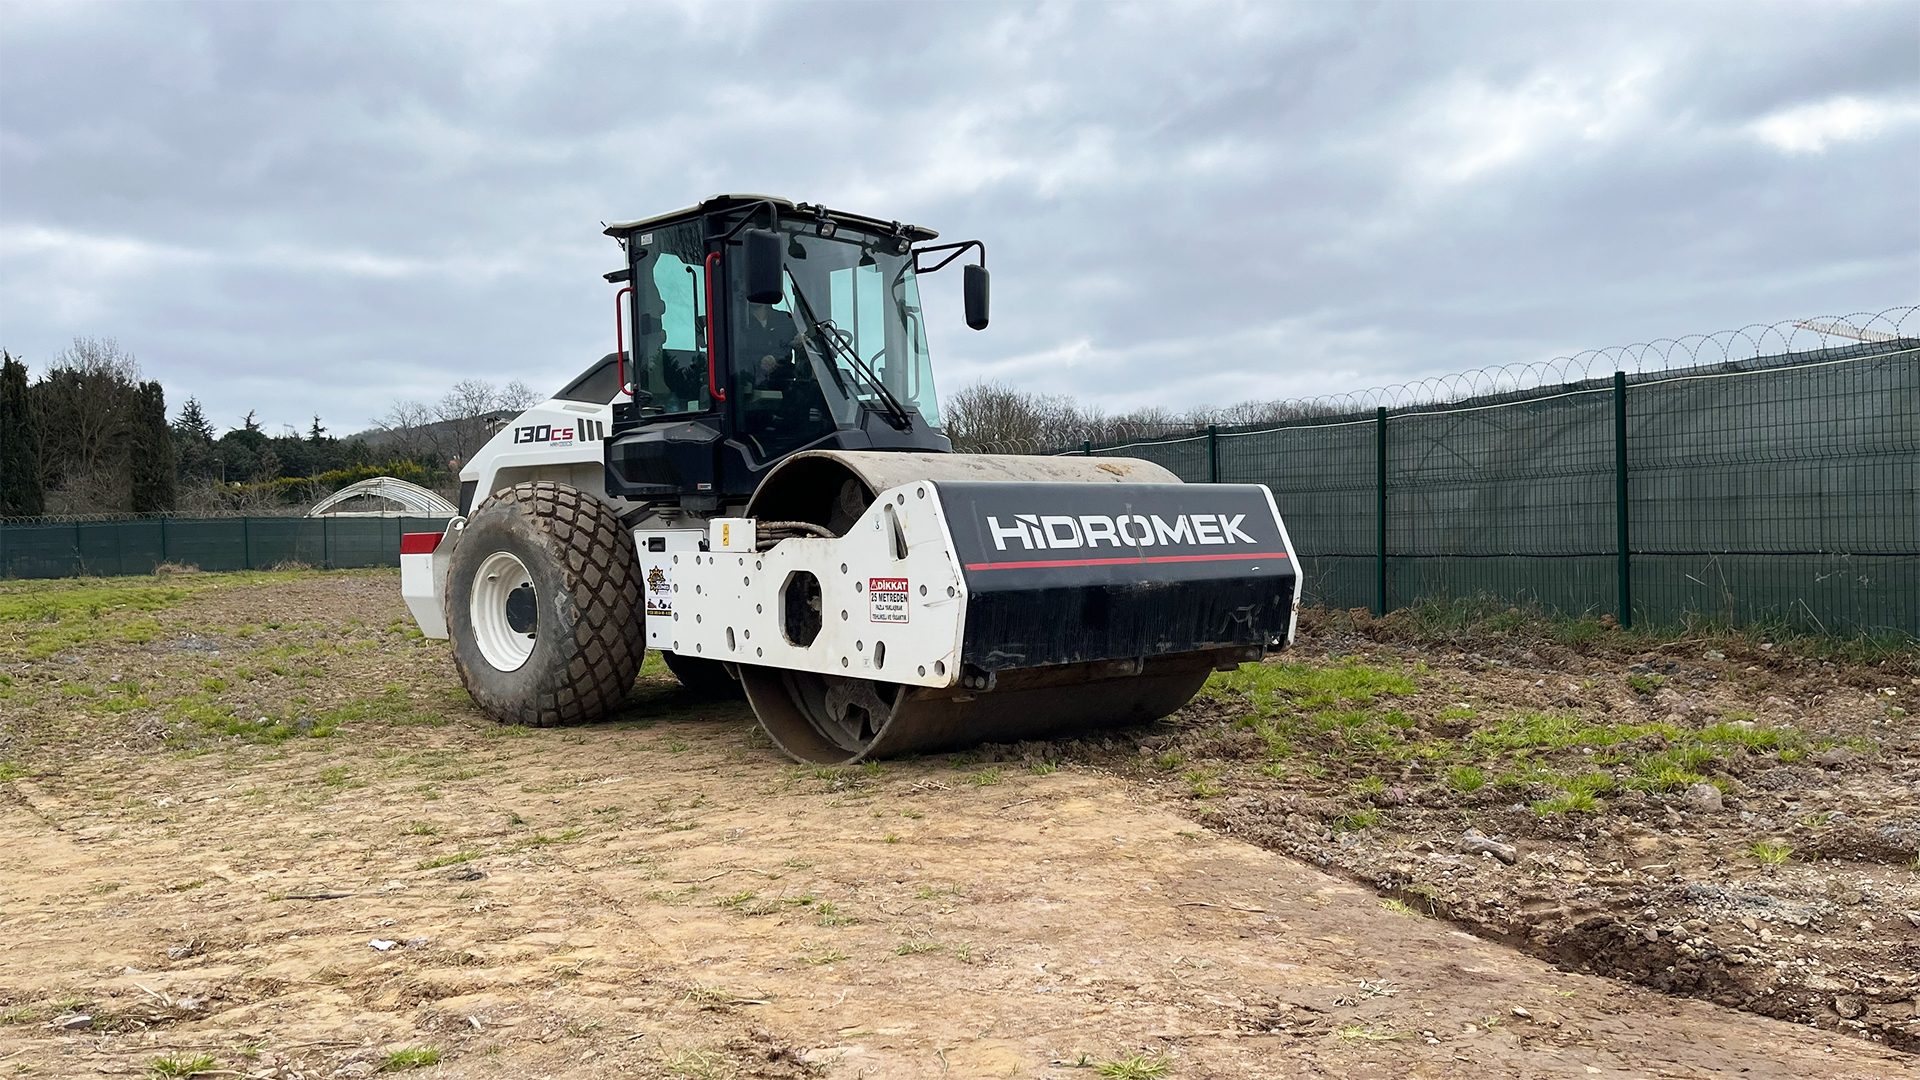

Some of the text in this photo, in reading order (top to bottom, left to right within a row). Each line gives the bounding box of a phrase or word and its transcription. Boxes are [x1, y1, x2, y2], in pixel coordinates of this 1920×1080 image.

[877, 580, 907, 590] DİKKAT
[871, 593, 907, 602] 25 METREDEN
